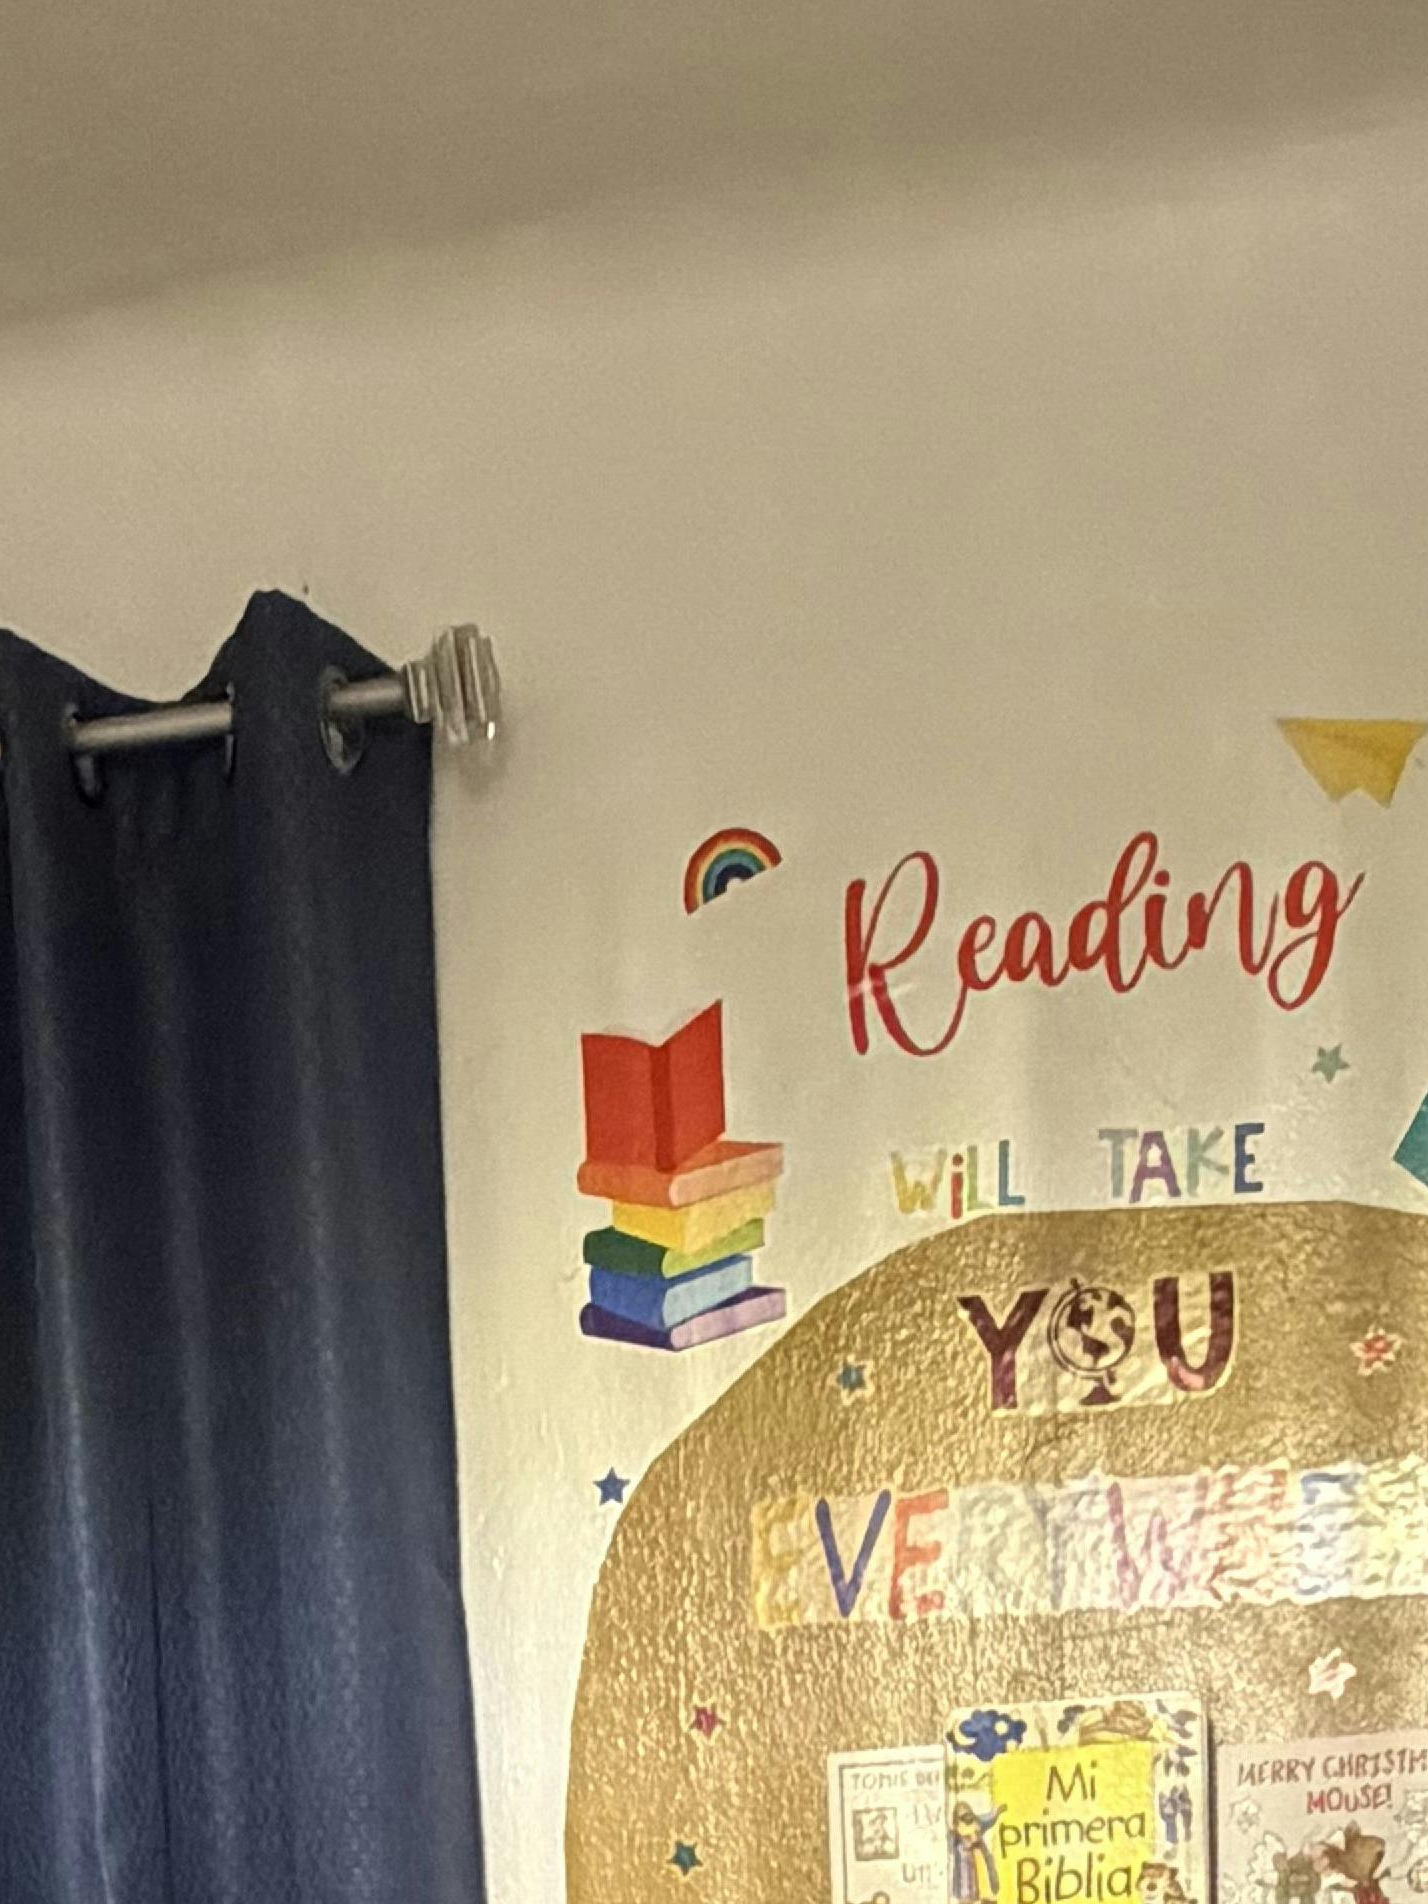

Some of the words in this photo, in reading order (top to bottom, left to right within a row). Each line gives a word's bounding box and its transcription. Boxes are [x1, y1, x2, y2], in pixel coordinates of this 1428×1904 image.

[844, 831, 1366, 1058] Reading
[1097, 1122, 1265, 1204] TAKE
[1046, 1759, 1098, 1802] Mi
[1236, 1756, 1316, 1787] MERRY
[1306, 1782, 1393, 1815] MOUSE!
[999, 1807, 1146, 1860] primera
